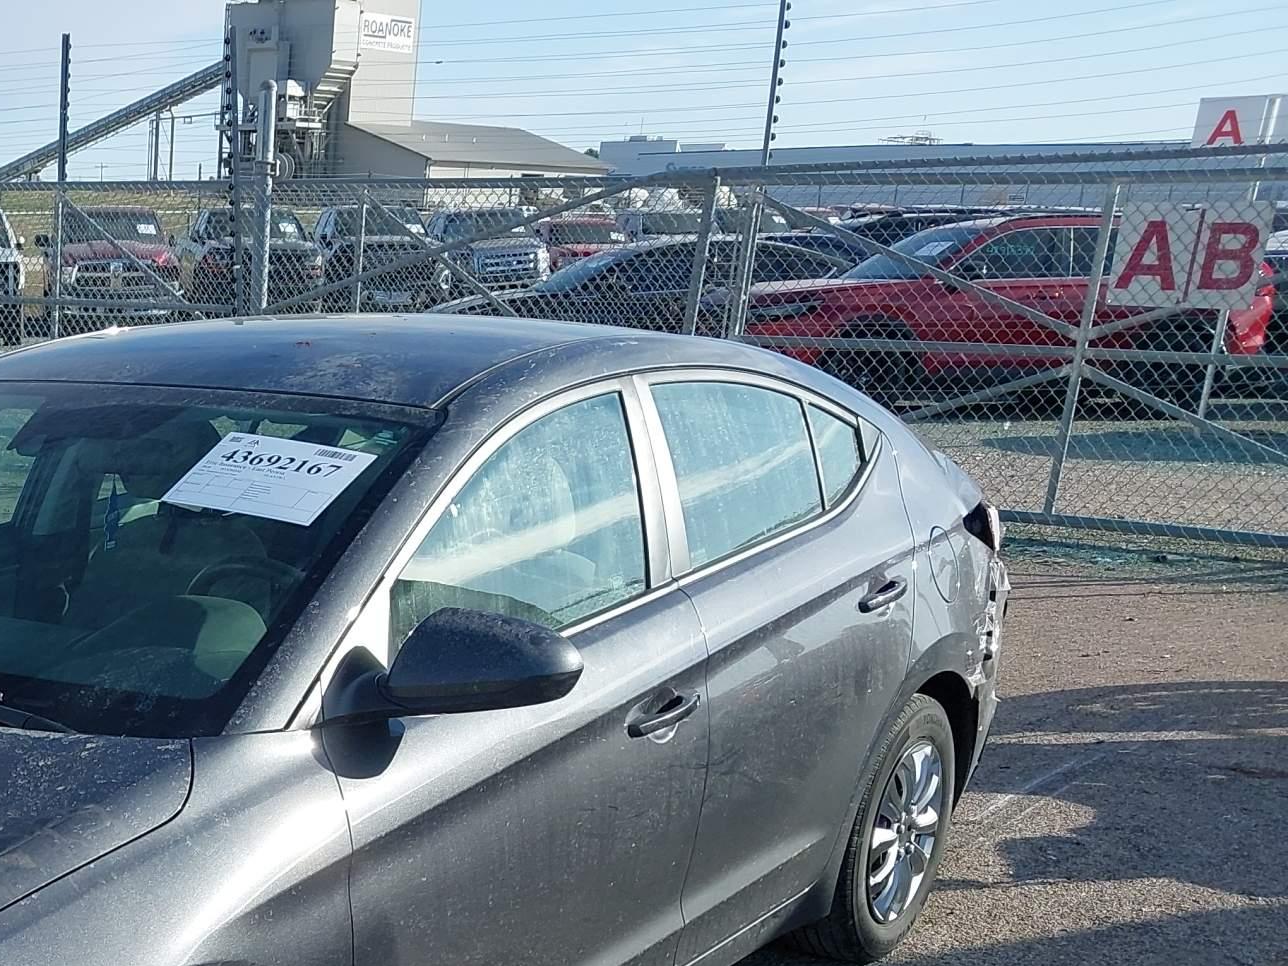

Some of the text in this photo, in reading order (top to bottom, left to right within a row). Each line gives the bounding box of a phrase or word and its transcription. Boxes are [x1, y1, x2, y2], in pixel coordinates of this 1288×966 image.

[363, 19, 413, 39] ROANOKE
[1206, 110, 1243, 145] A
[1114, 220, 1260, 291] A B
[221, 448, 343, 478] 43692167
